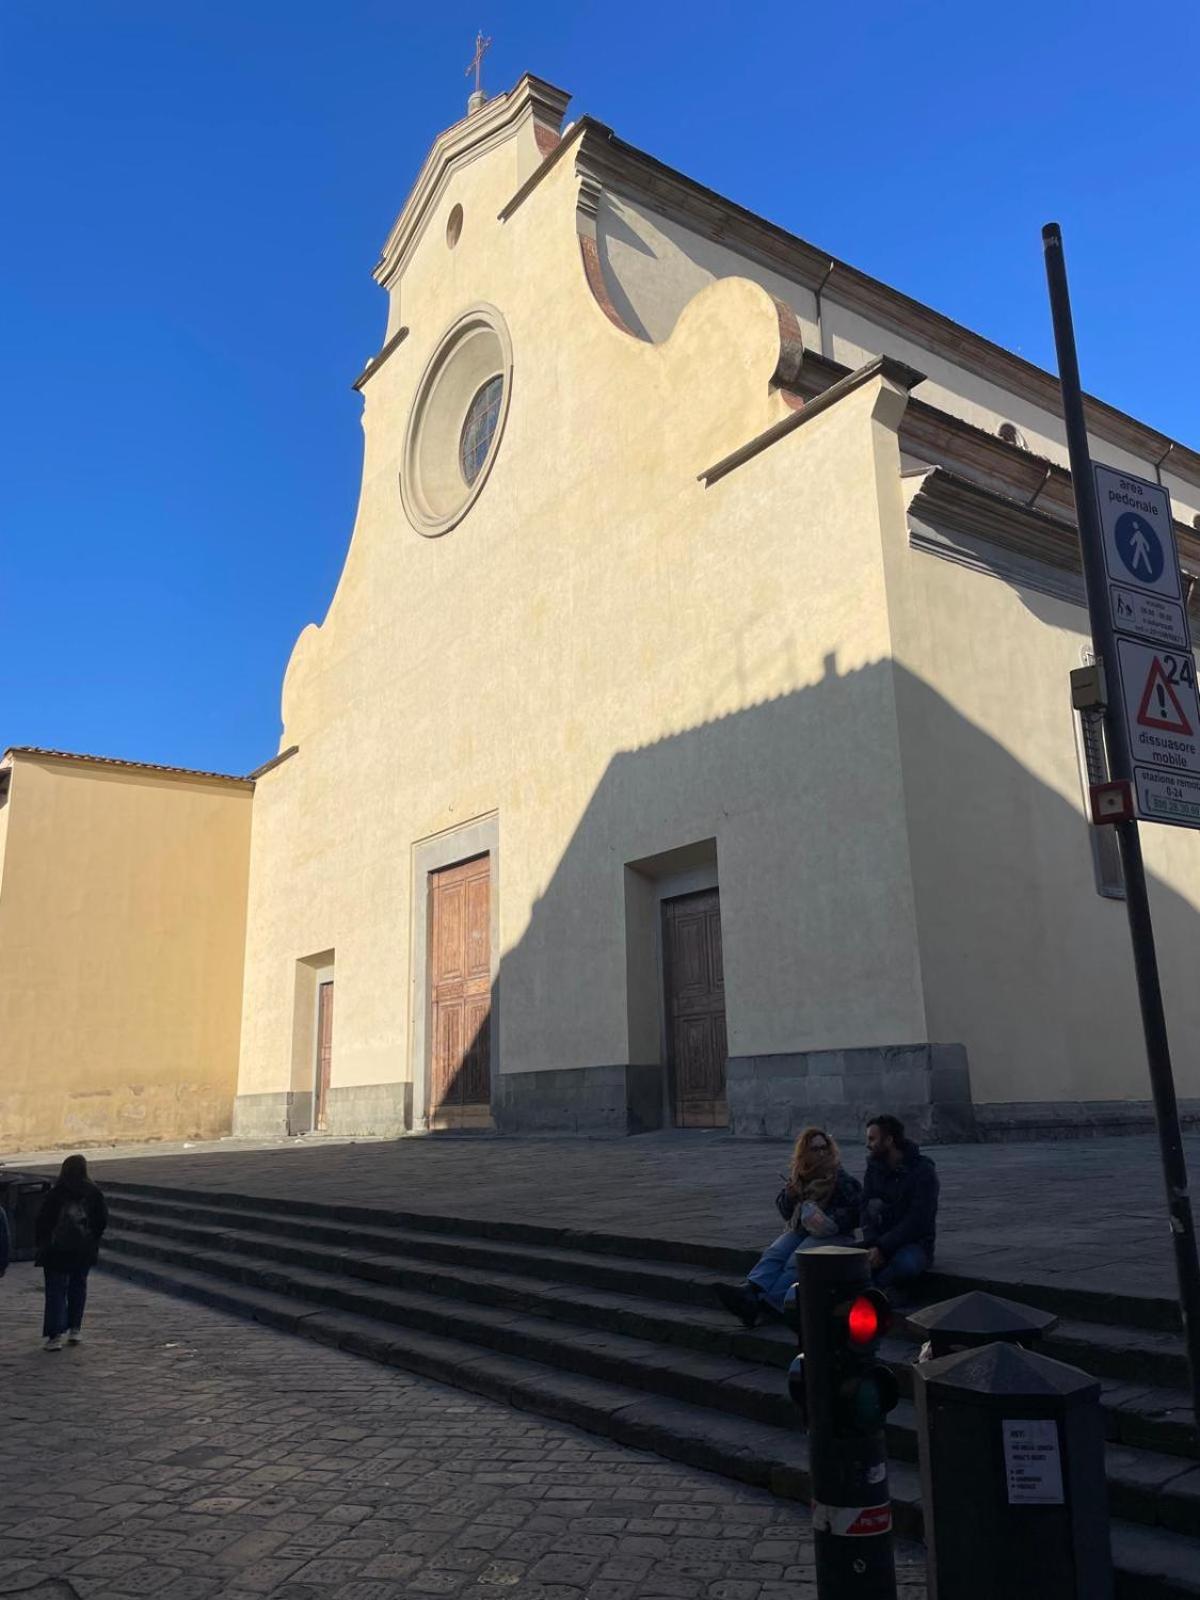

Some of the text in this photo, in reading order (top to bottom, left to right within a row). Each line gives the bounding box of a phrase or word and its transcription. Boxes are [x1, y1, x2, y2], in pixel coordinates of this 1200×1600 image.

[1119, 479, 1144, 496] area
[1108, 489, 1159, 516] pedonale
[1163, 654, 1194, 689] 24
[1138, 731, 1197, 754] dissuasore
[1152, 751, 1188, 768] mobile
